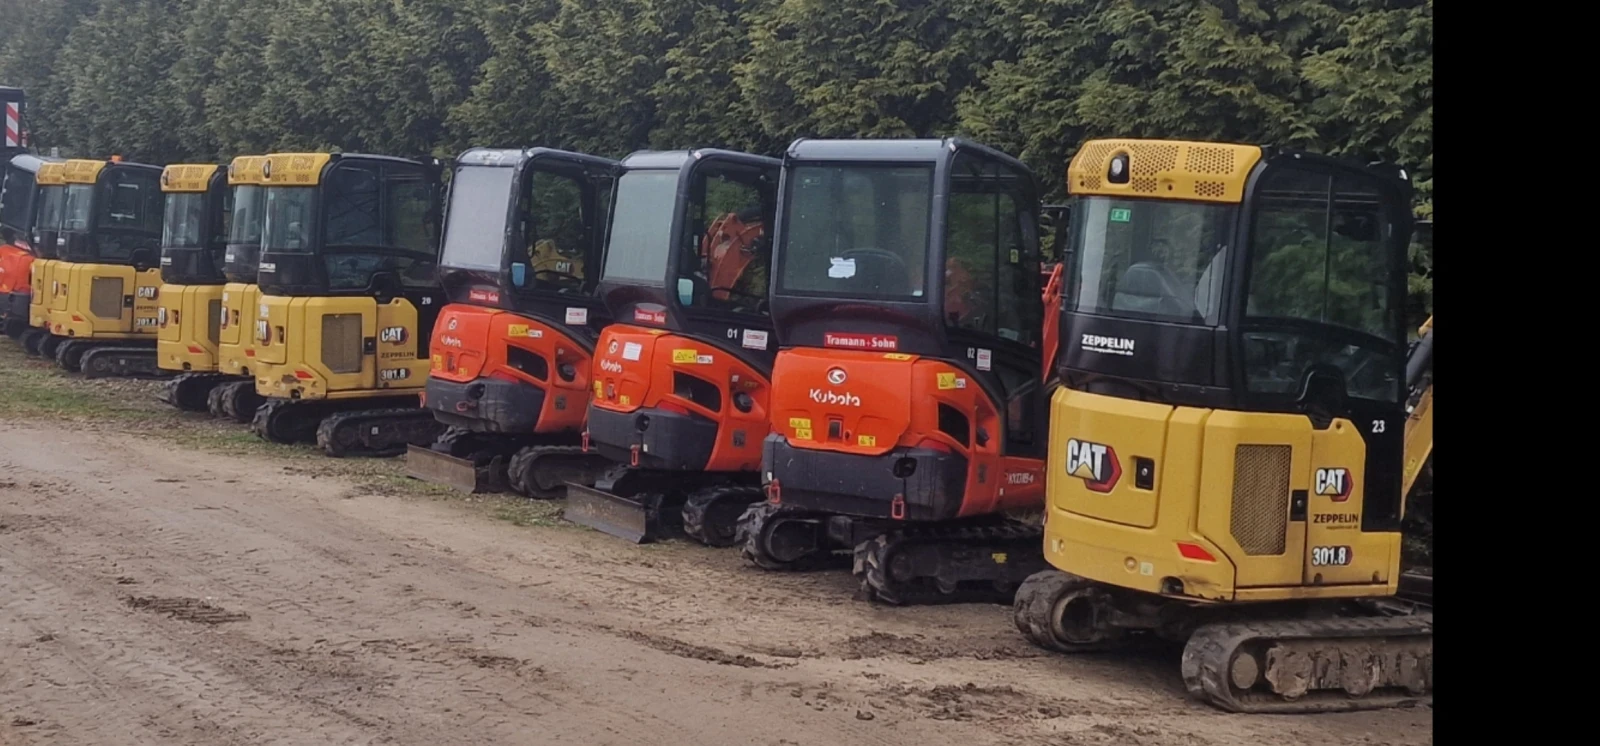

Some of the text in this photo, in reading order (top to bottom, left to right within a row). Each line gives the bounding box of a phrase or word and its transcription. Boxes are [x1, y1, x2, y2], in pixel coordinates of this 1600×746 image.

[556, 261, 571, 272] CAT
[138, 286, 155, 298] CAT
[421, 297, 432, 305] 20
[381, 327, 403, 342] CAT
[727, 328, 738, 339] 01
[1081, 333, 1134, 350] ZEPPELIN
[380, 351, 414, 359] ZEPPELIN
[967, 347, 975, 359] 02
[380, 368, 406, 380] 301.8
[809, 388, 860, 407] Kubota
[1372, 419, 1385, 433] 23
[1066, 438, 1107, 480] CAT
[1315, 468, 1345, 495] CAT
[1313, 513, 1358, 524] ZEPPELIN
[1312, 547, 1346, 565] 301.8
